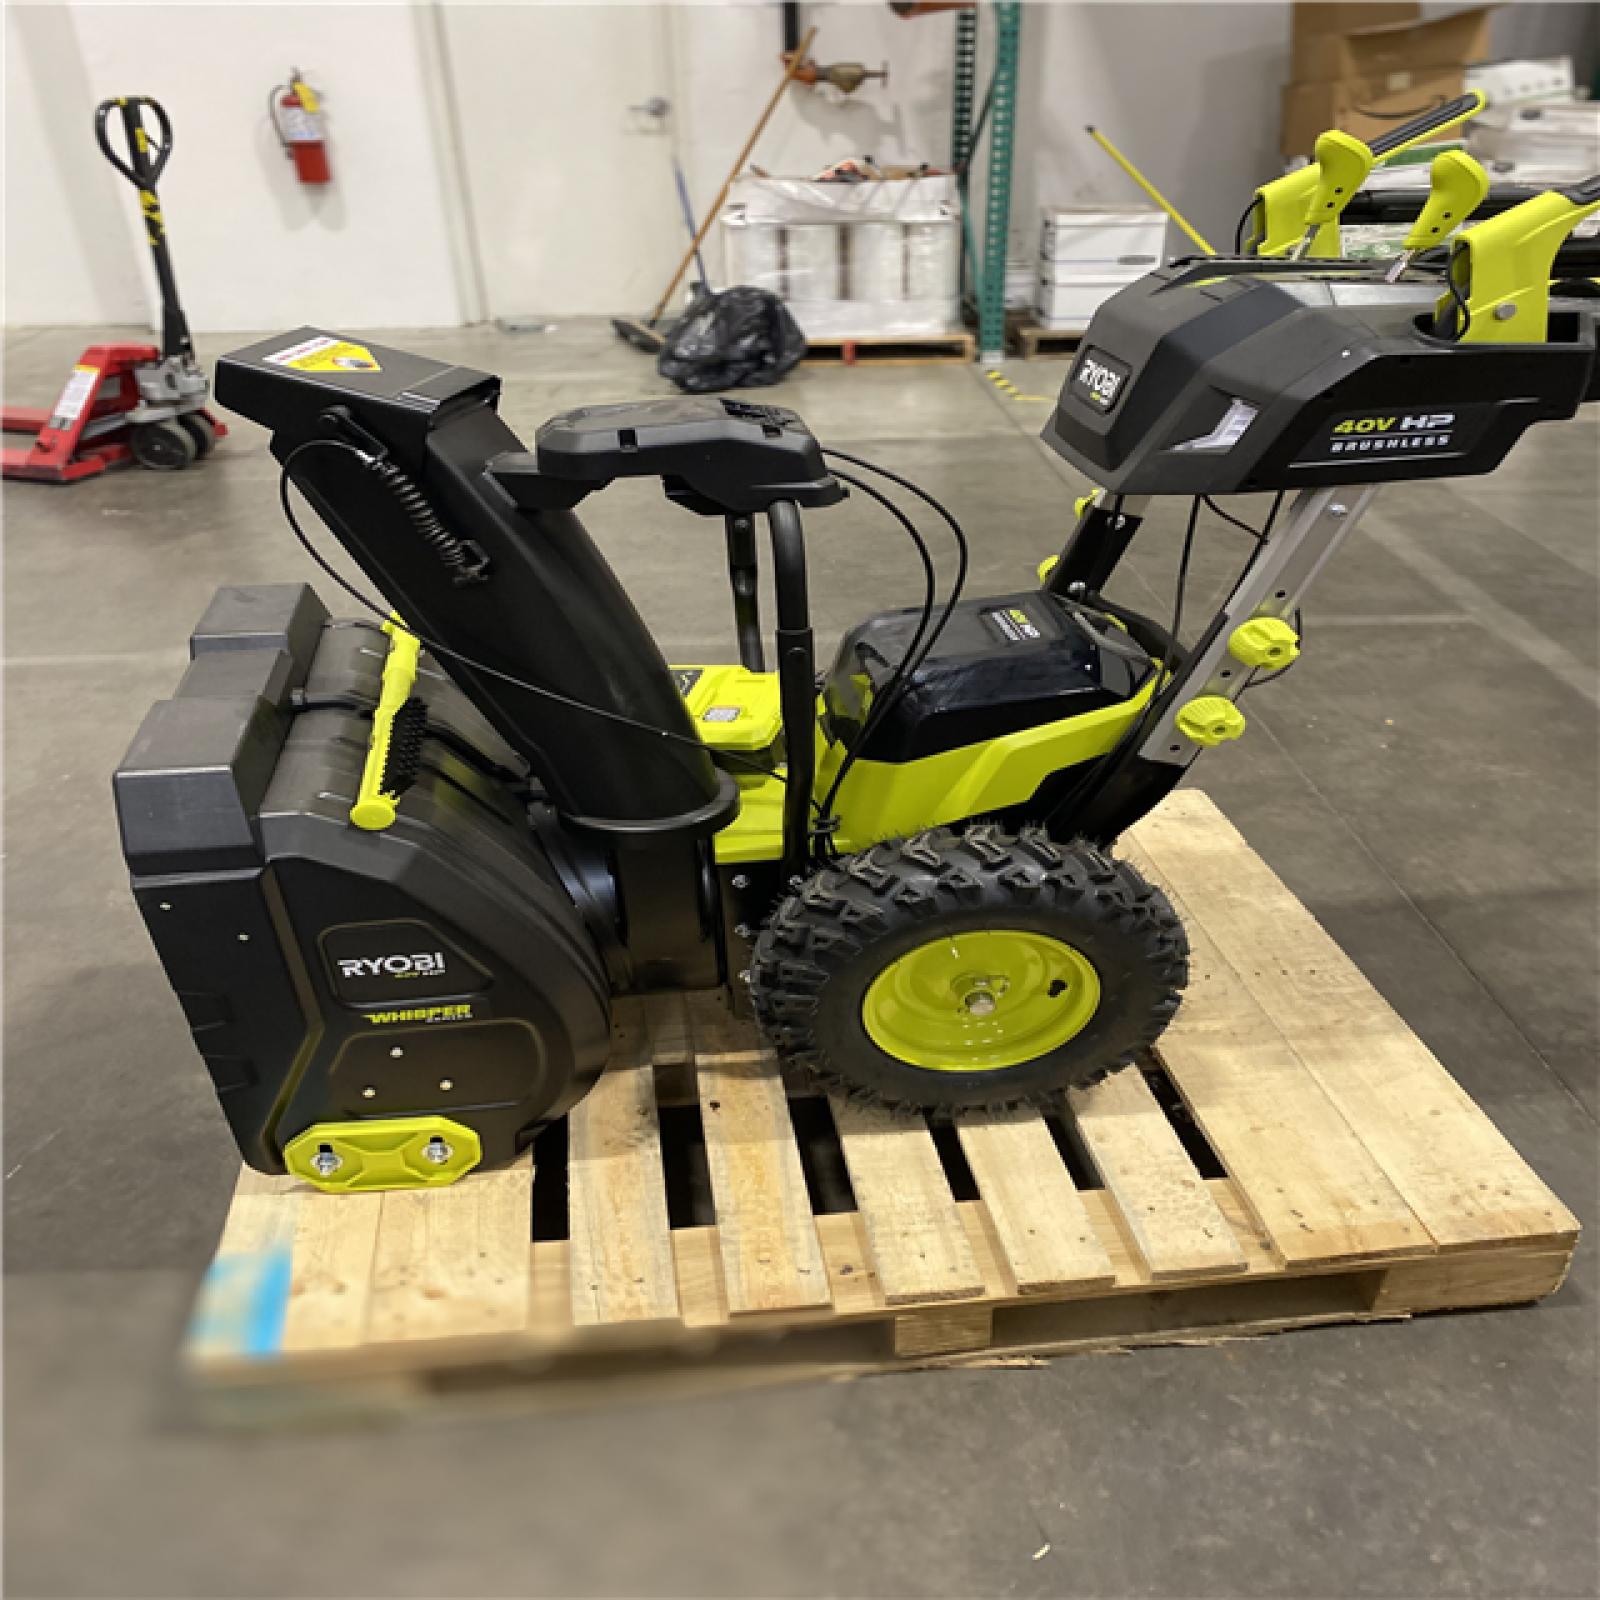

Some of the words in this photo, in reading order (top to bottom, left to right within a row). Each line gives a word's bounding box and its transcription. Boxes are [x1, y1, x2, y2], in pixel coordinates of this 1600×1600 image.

[1080, 359, 1120, 399] RYOBI
[1333, 417, 1397, 433] 40V
[1400, 414, 1455, 431] HP
[1330, 435, 1449, 452] BRUSHLESS
[337, 952, 445, 978] RYOBI
[361, 1004, 471, 1024] WHISPER
